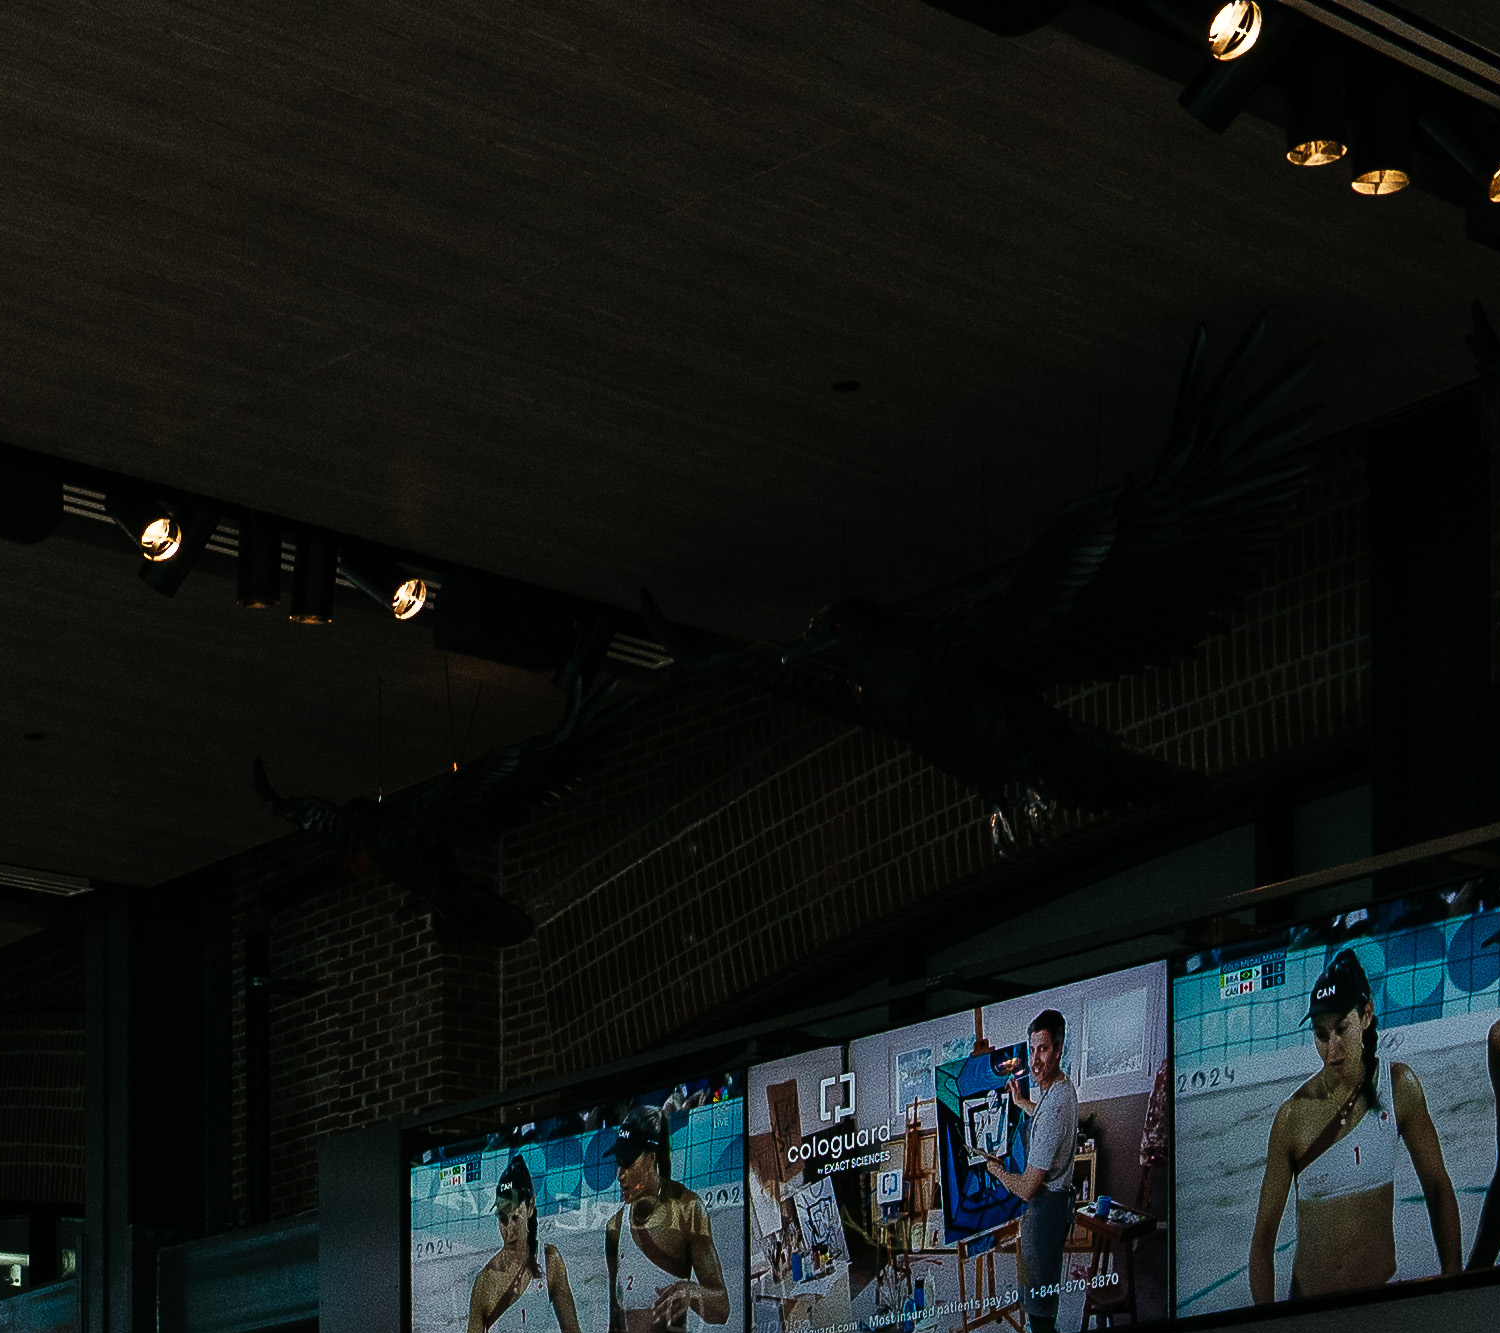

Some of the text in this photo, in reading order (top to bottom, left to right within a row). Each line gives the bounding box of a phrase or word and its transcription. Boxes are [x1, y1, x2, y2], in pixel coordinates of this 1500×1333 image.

[1316, 985, 1336, 1000] CAN
[787, 1120, 891, 1164] cologuard
[824, 1158, 850, 1175] EXACT
[851, 1150, 891, 1169] SCIENCES
[1353, 1145, 1361, 1165] 1
[869, 1313, 895, 1327] Most
[897, 1306, 936, 1323] insured
[937, 1296, 981, 1316] patients
[983, 1295, 1003, 1311] pay
[1004, 1289, 1019, 1304] $0
[1029, 1272, 1120, 1300] 1-844-870-8870
